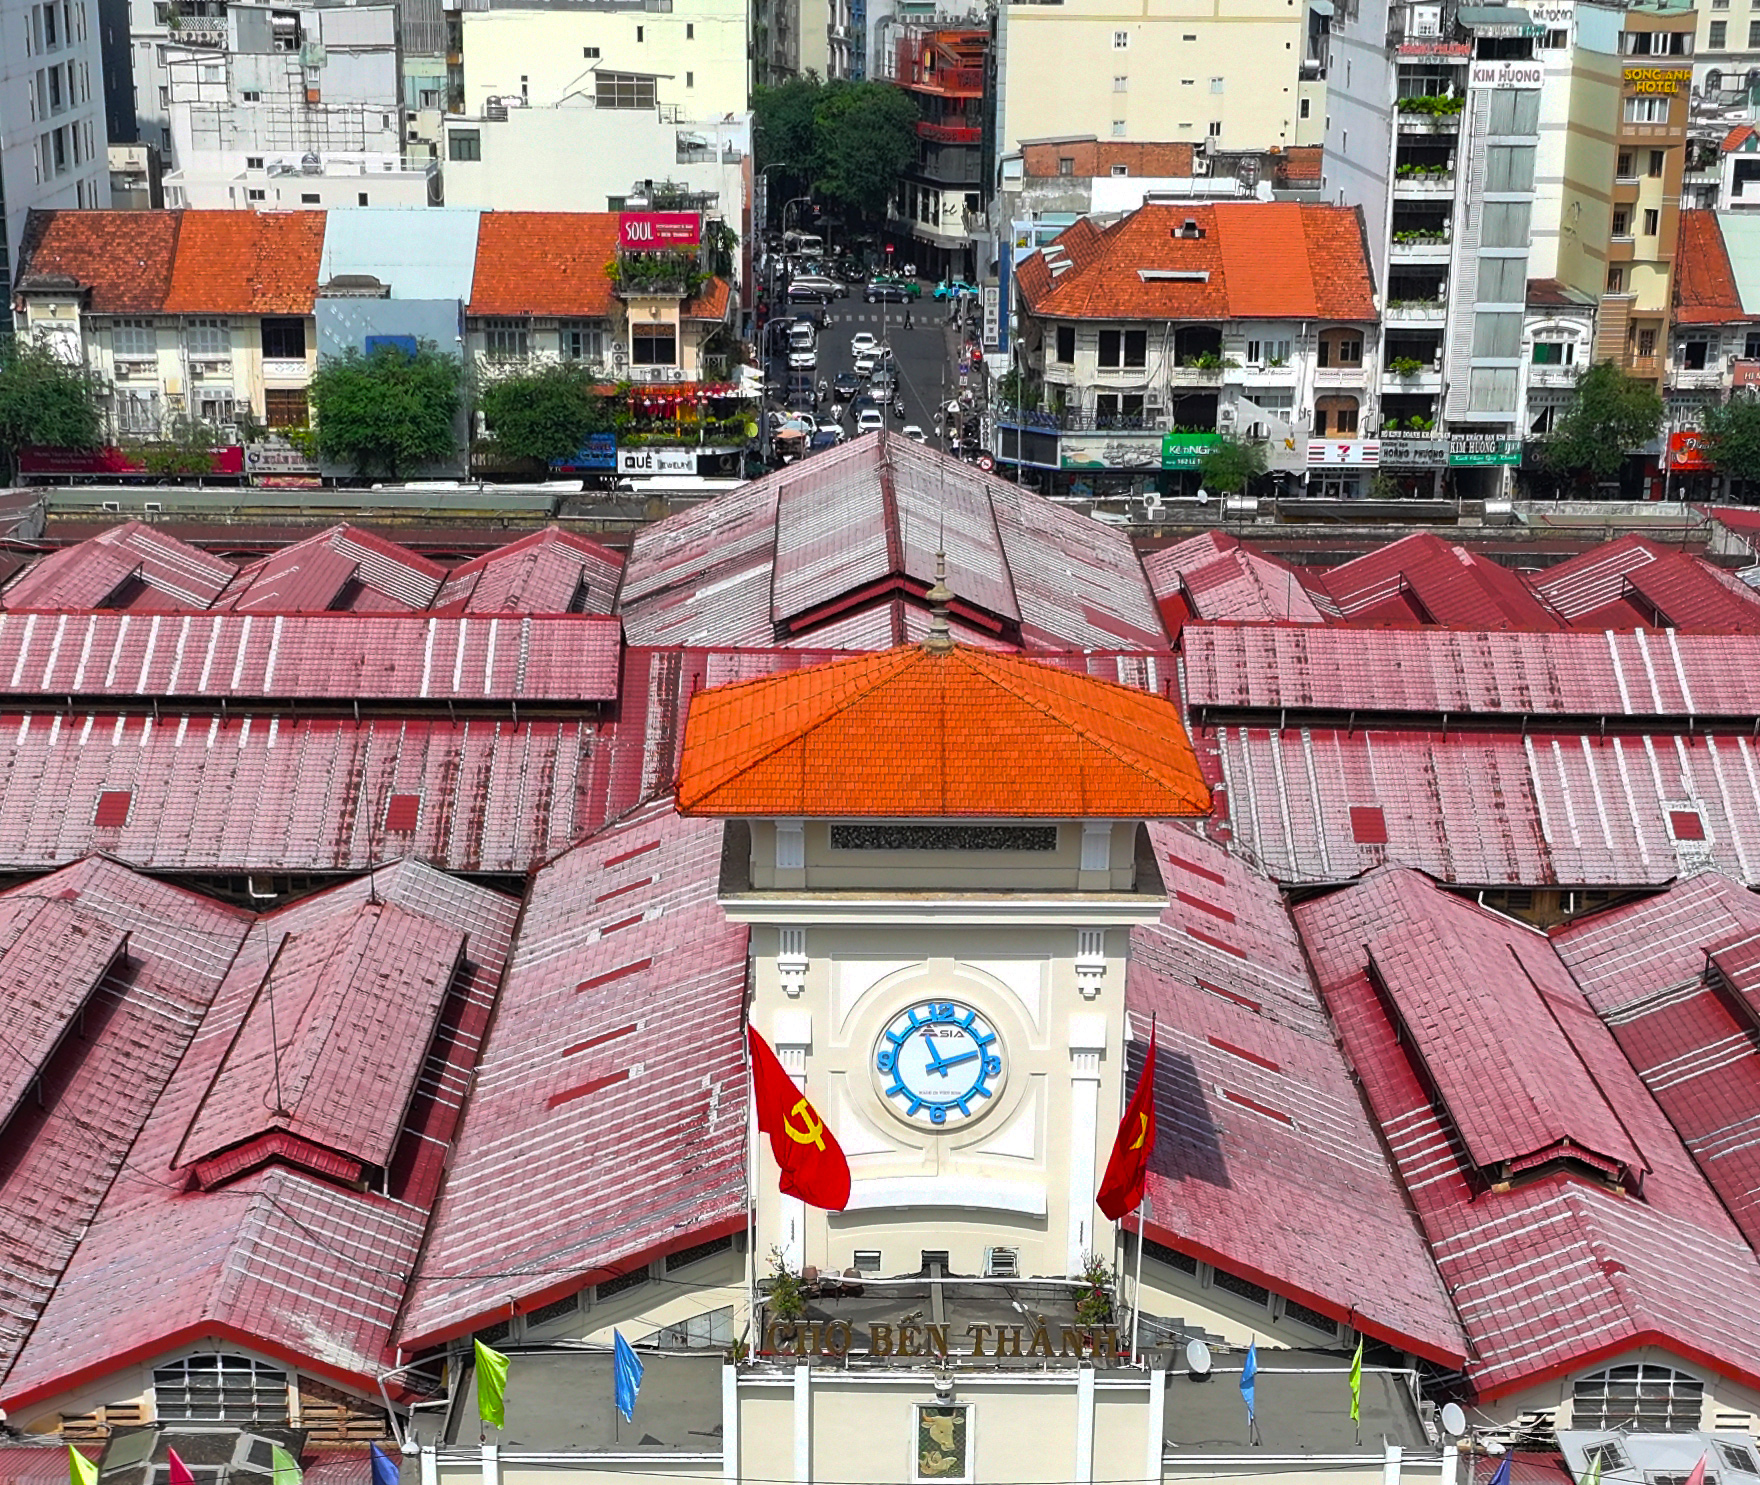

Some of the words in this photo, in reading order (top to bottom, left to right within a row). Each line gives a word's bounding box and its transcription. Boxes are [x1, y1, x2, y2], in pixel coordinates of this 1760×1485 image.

[1473, 69, 1495, 82] KIM
[1635, 81, 1678, 93] HOTEL
[625, 222, 653, 241] SOUL
[1450, 442, 1466, 453] KIM
[928, 1003, 955, 1021] 12
[877, 1050, 895, 1071] 9
[984, 1055, 1001, 1075] 3
[930, 1105, 947, 1123] 6
[965, 1314, 1121, 1360] THÀNH
